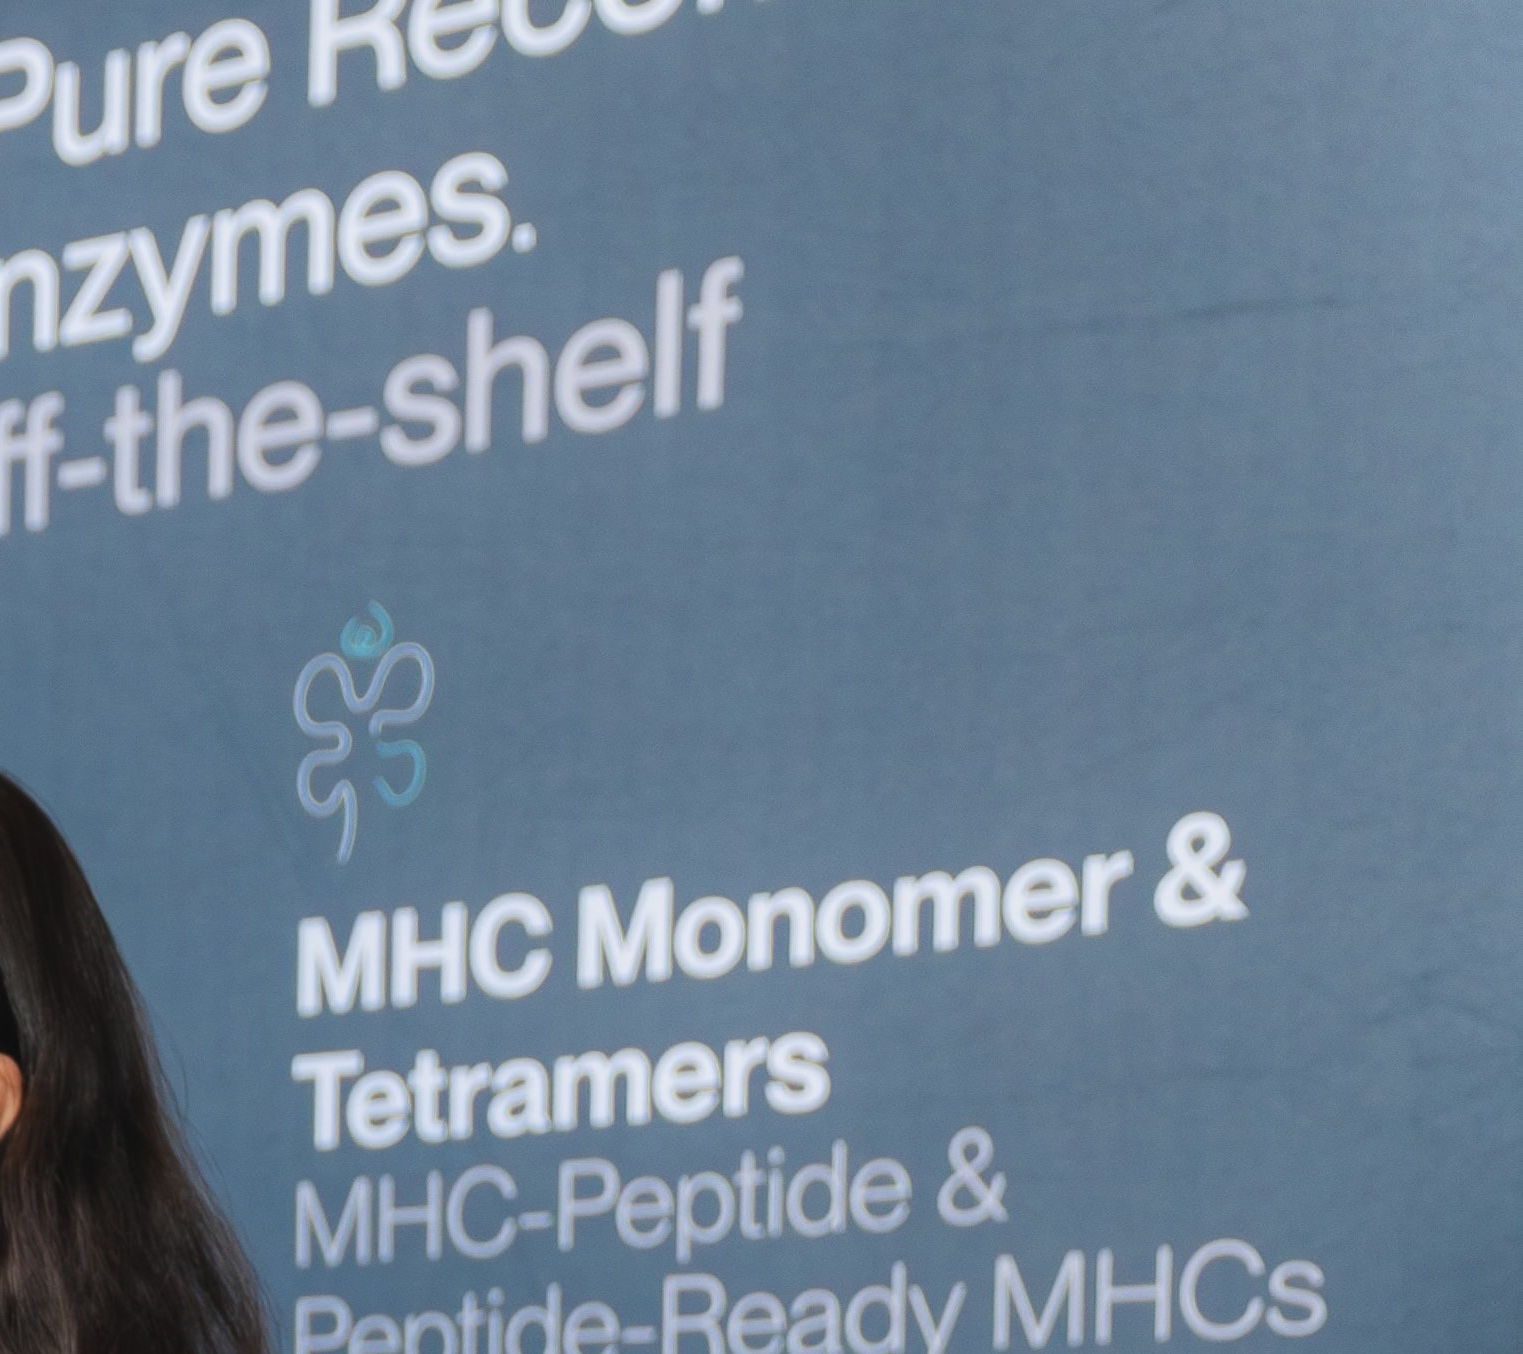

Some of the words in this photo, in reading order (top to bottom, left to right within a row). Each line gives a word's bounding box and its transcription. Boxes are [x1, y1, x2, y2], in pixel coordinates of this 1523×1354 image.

[295, 892, 555, 1017] MHC
[575, 847, 1137, 990] Monomer
[1151, 809, 1249, 929] &
[289, 1028, 832, 1152] Tetramers
[294, 1138, 913, 1270] MHC-Peptide
[935, 1124, 1009, 1227] &
[989, 1236, 1329, 1352] MHCs
